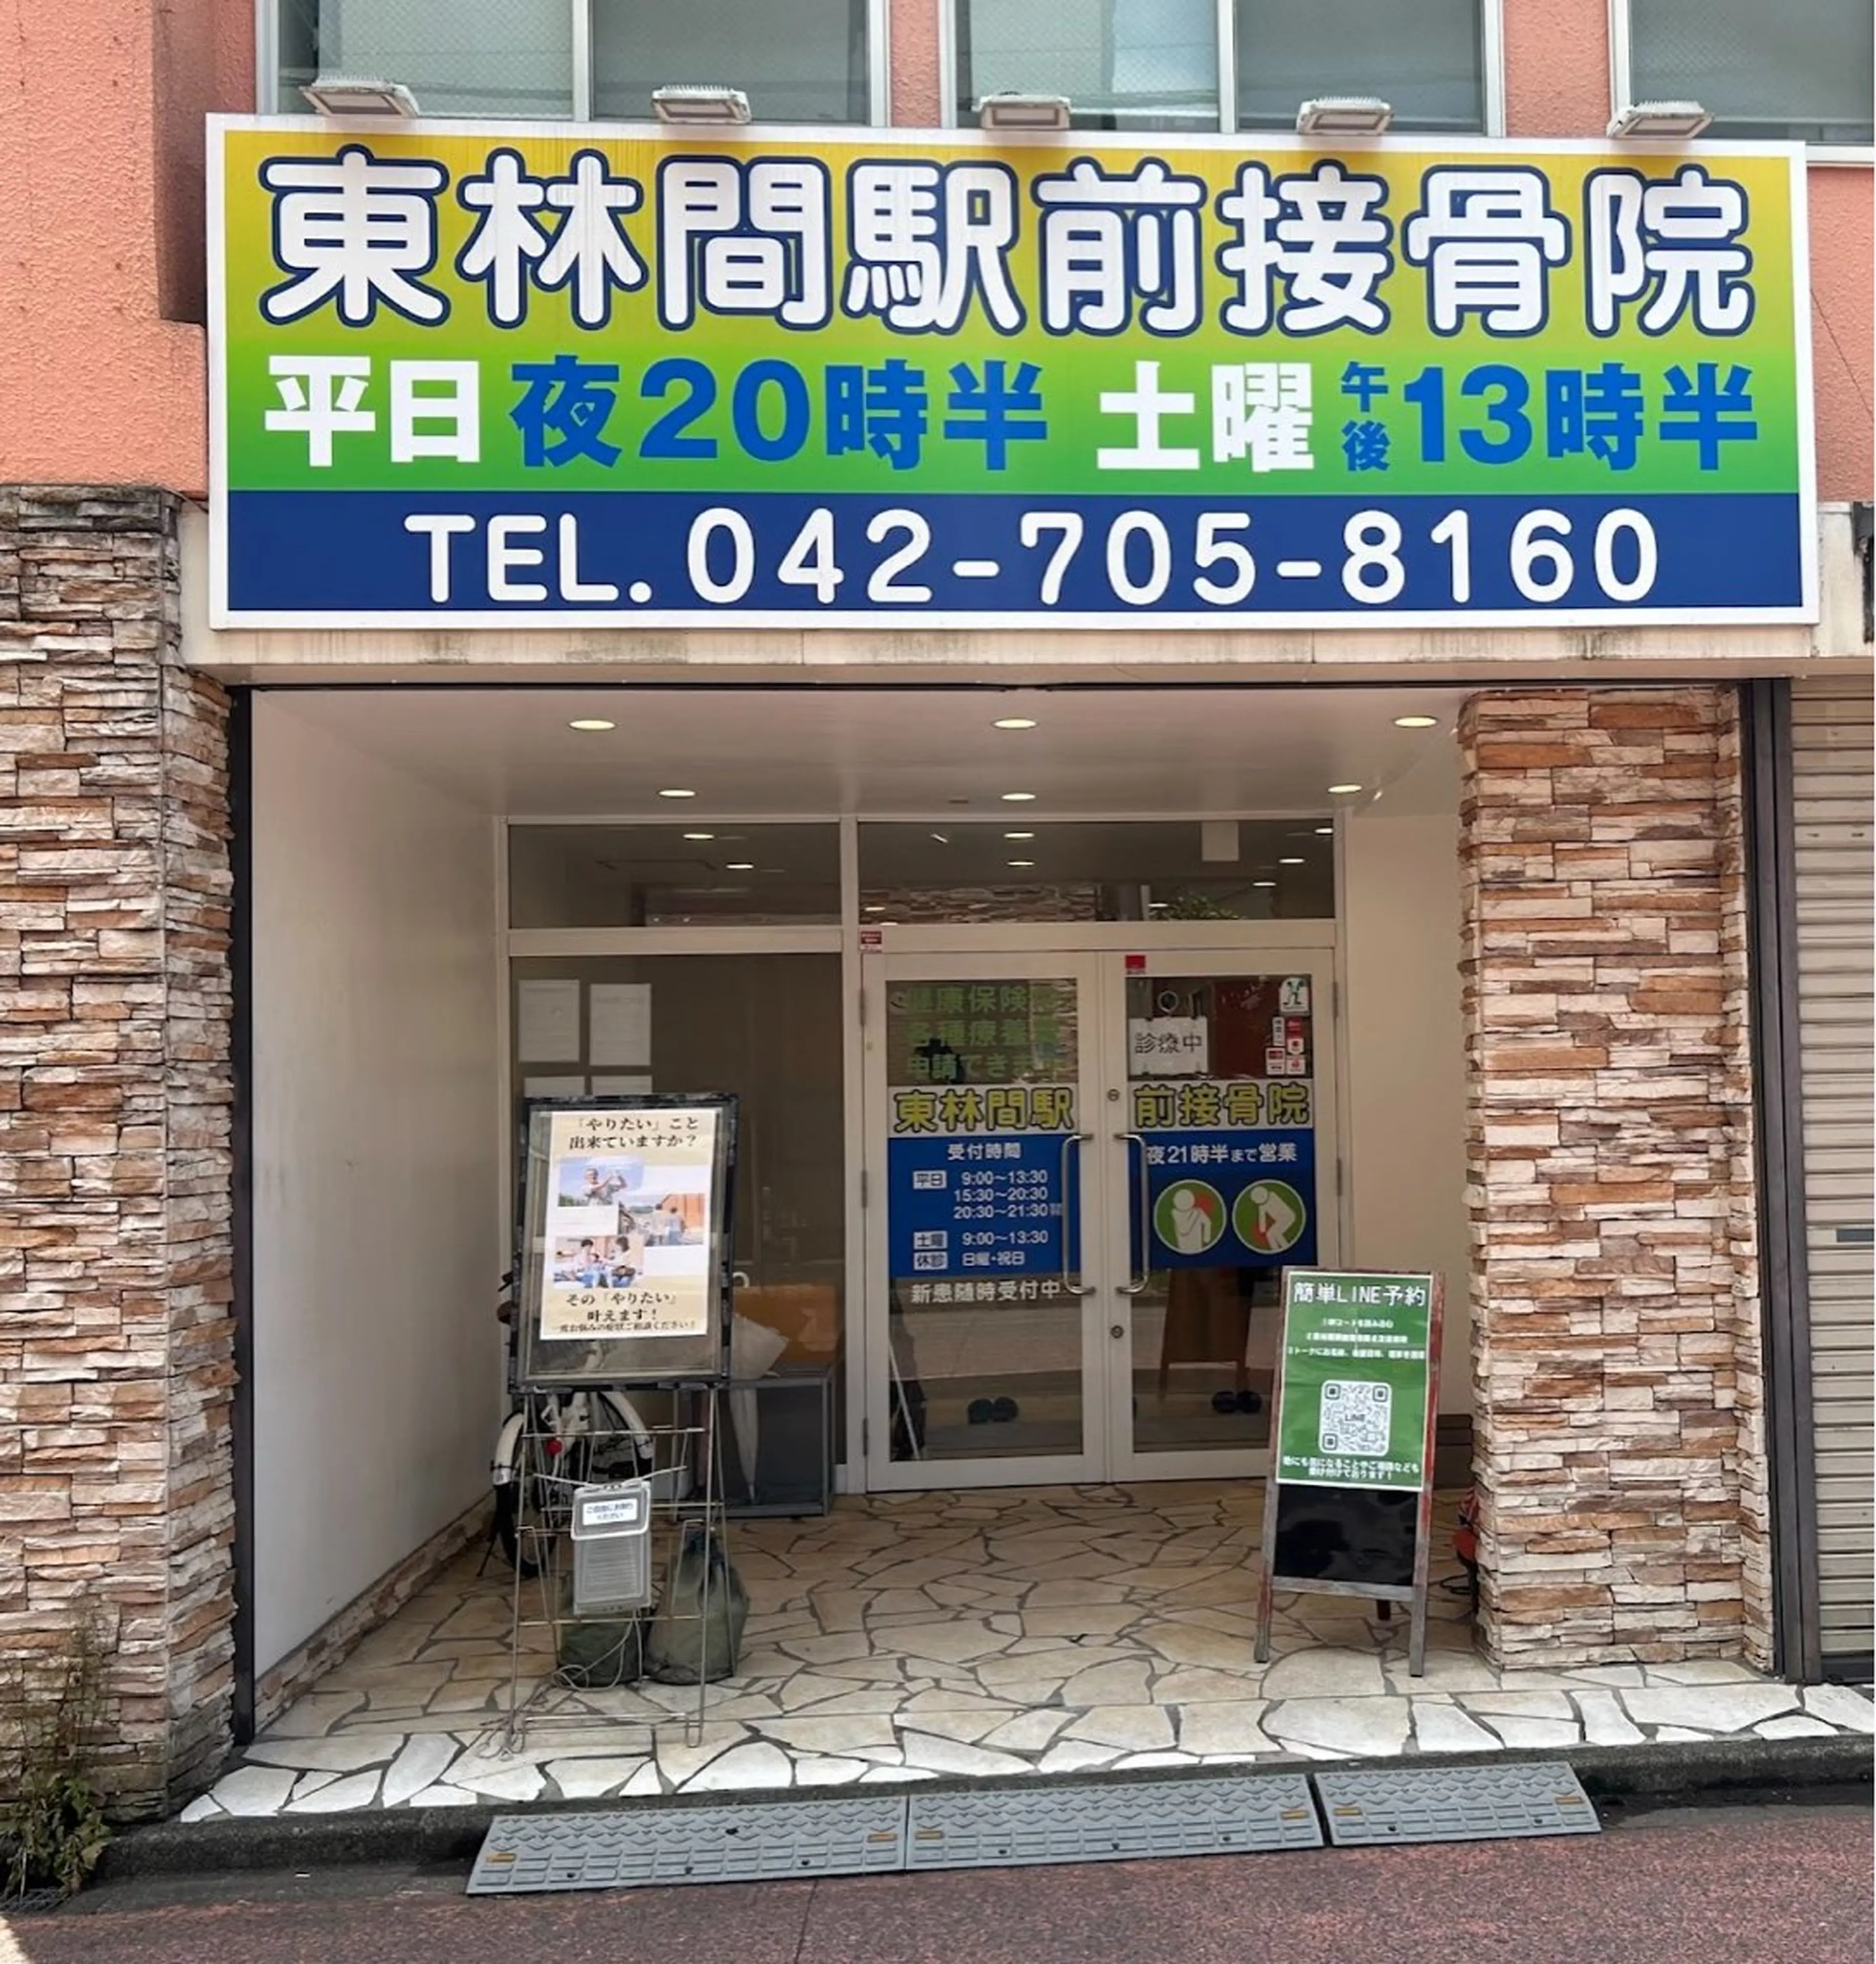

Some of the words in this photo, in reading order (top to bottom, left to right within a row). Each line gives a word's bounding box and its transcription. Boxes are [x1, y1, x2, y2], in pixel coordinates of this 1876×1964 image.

[258, 148, 1753, 338] 東林間駅前接骨院
[404, 512, 653, 604] TEL.
[686, 507, 1658, 606] 042-705-8160
[1134, 1032, 1202, 1054] 診療中
[893, 1088, 1075, 1133] 東林間駅
[1132, 1082, 1310, 1129] 前接骨院
[947, 1141, 1022, 1161] 受付時間
[1147, 1141, 1298, 1165] 夜21時半まで営業
[916, 1173, 944, 1188] 平日
[917, 1233, 945, 1248] 土曜
[916, 1254, 945, 1268] 休診
[910, 1279, 1061, 1304] 新患随時受付中
[1294, 1281, 1426, 1307] 簡単LINE予約
